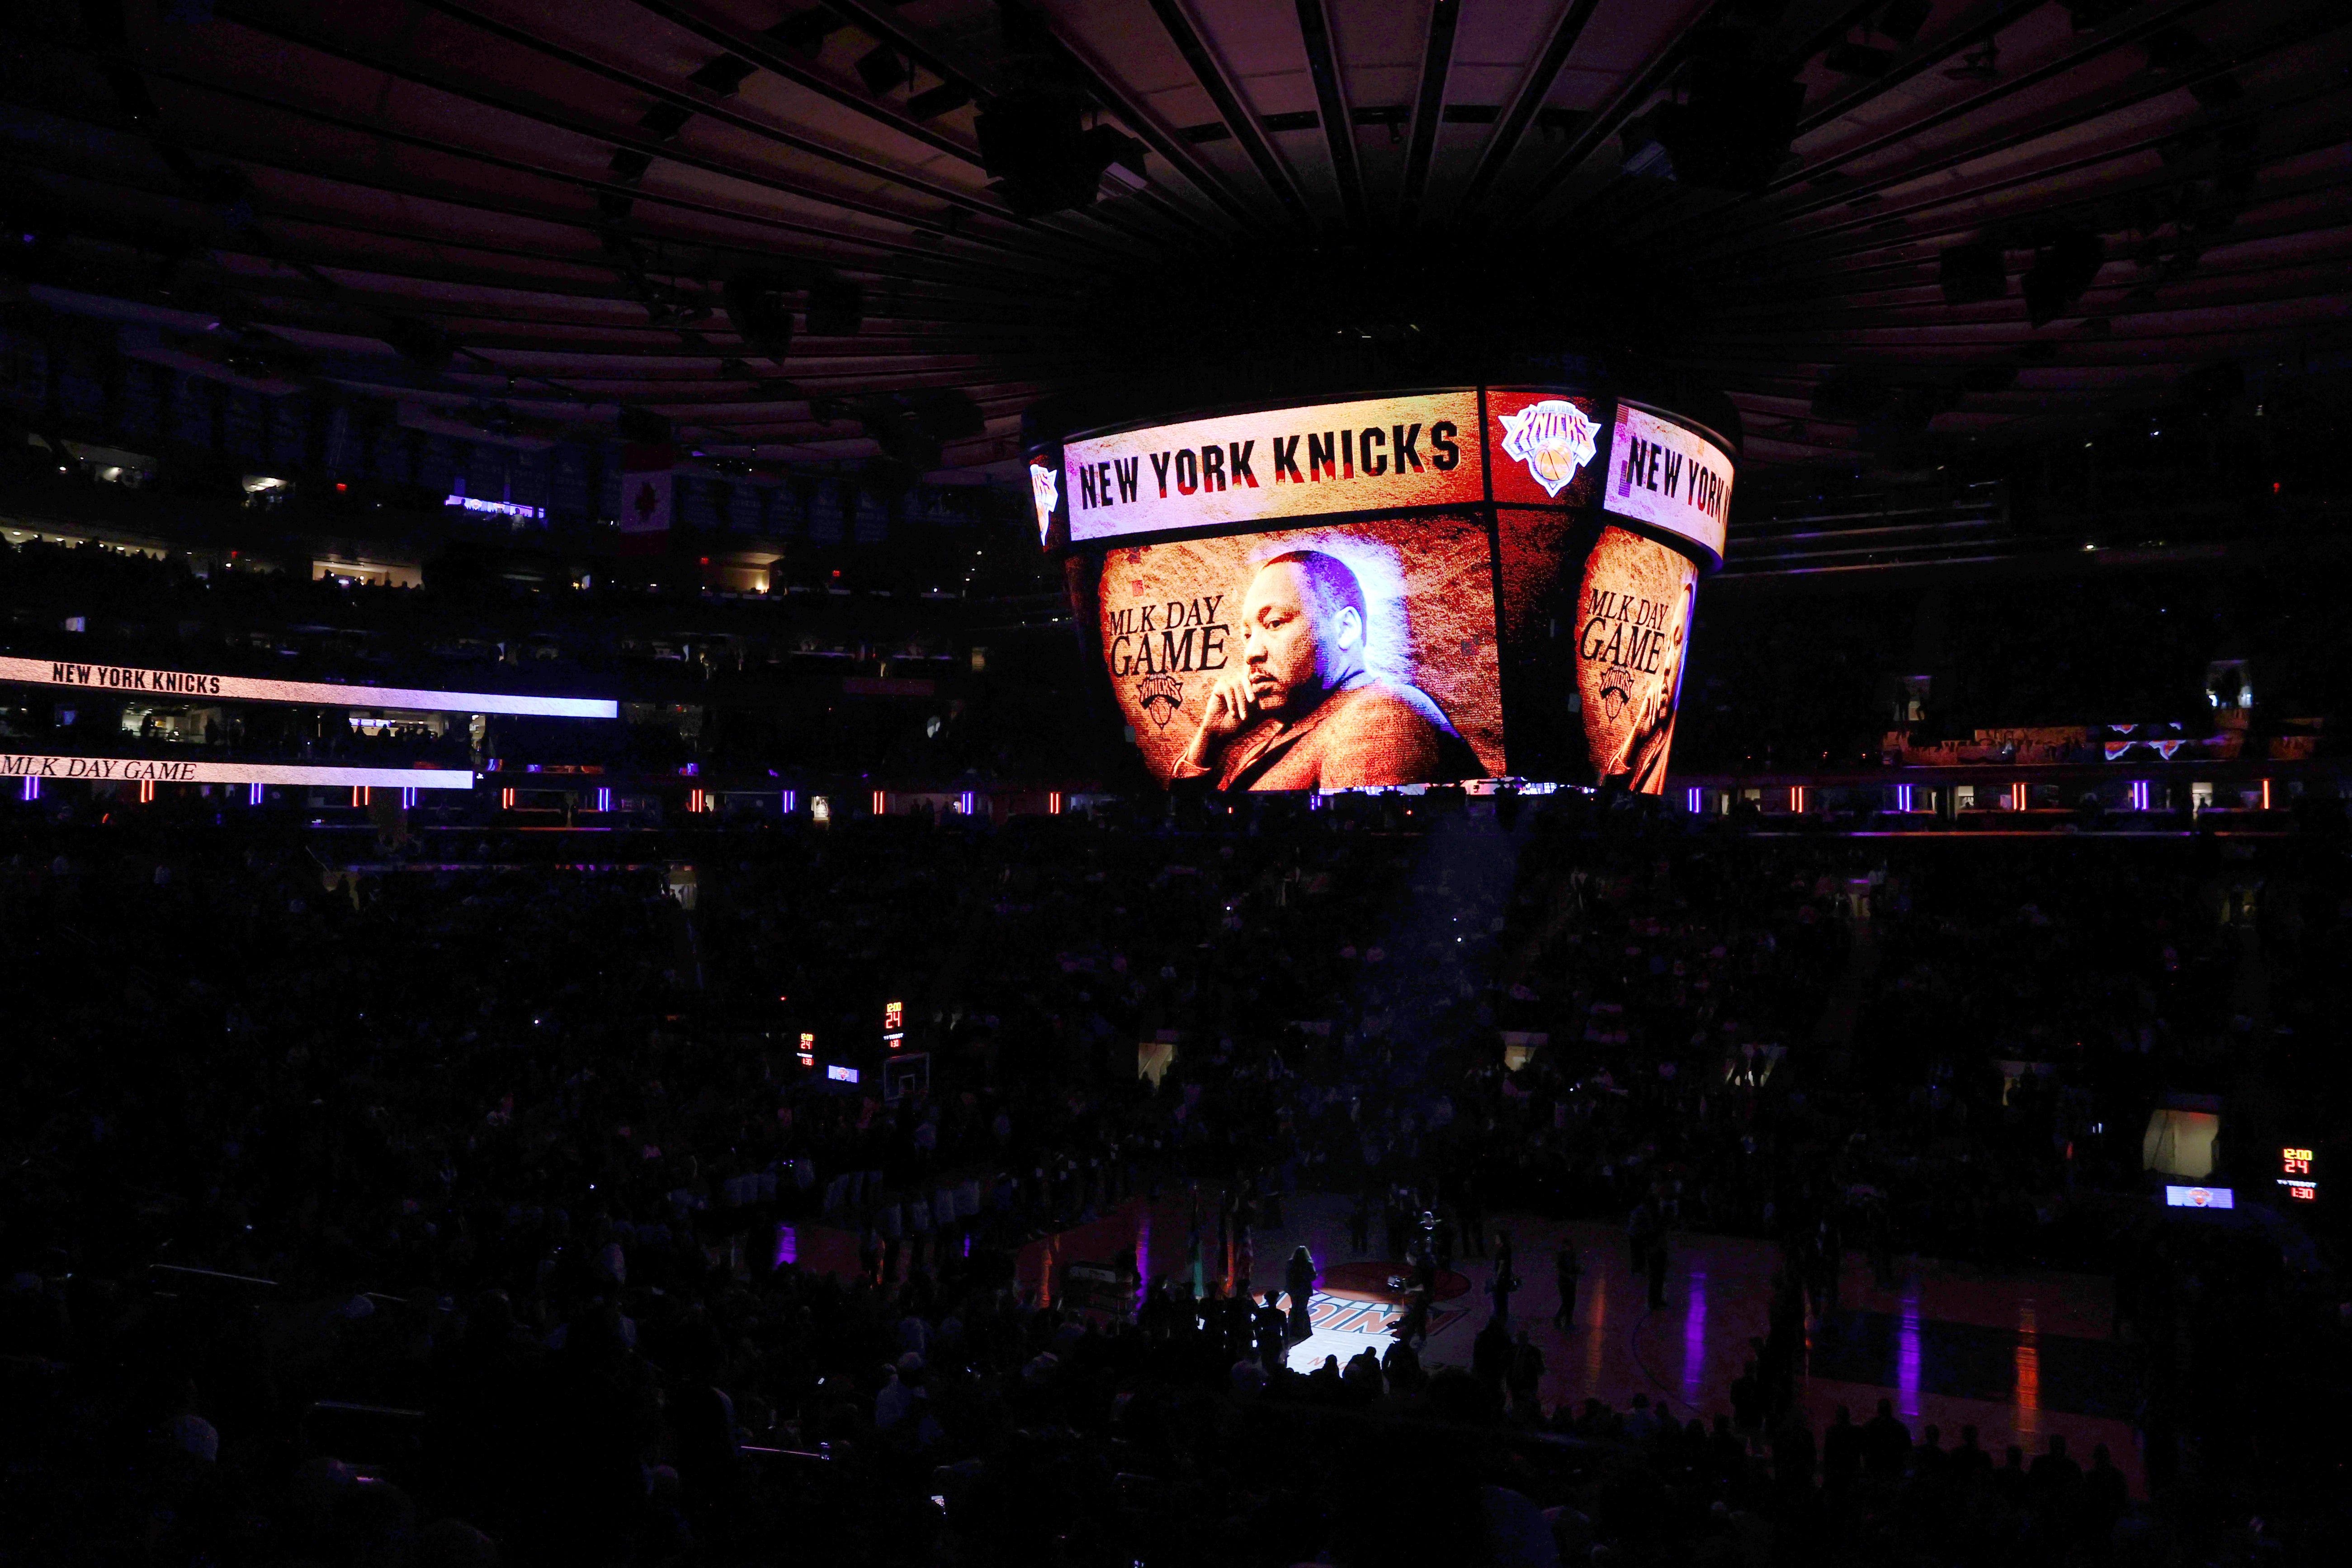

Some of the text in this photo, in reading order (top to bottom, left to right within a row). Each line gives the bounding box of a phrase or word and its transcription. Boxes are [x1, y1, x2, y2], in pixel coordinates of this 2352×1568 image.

[1507, 411, 1592, 450] KNICKS
[1079, 420, 1459, 509] NEW YORK KNICKS
[1626, 435, 1682, 498] NEW
[1688, 458, 1724, 523] YORK
[1109, 595, 1224, 636] MLK DAY
[1587, 589, 1669, 630] MLK DAY
[1111, 624, 1230, 677] GAME
[1581, 617, 1665, 674] GAME
[53, 663, 220, 694] NEW YORK KNICKS
[1140, 678, 1181, 702] KNICKS
[0, 756, 197, 780] MLK DAY GAME
[886, 1012, 900, 1028] 24
[887, 1002, 901, 1012] 12:00
[801, 1041, 810, 1049] 24
[2284, 1149, 2312, 1161] 12:00
[2285, 1160, 2308, 1173] 24
[2292, 1187, 2313, 1199] 1:30
